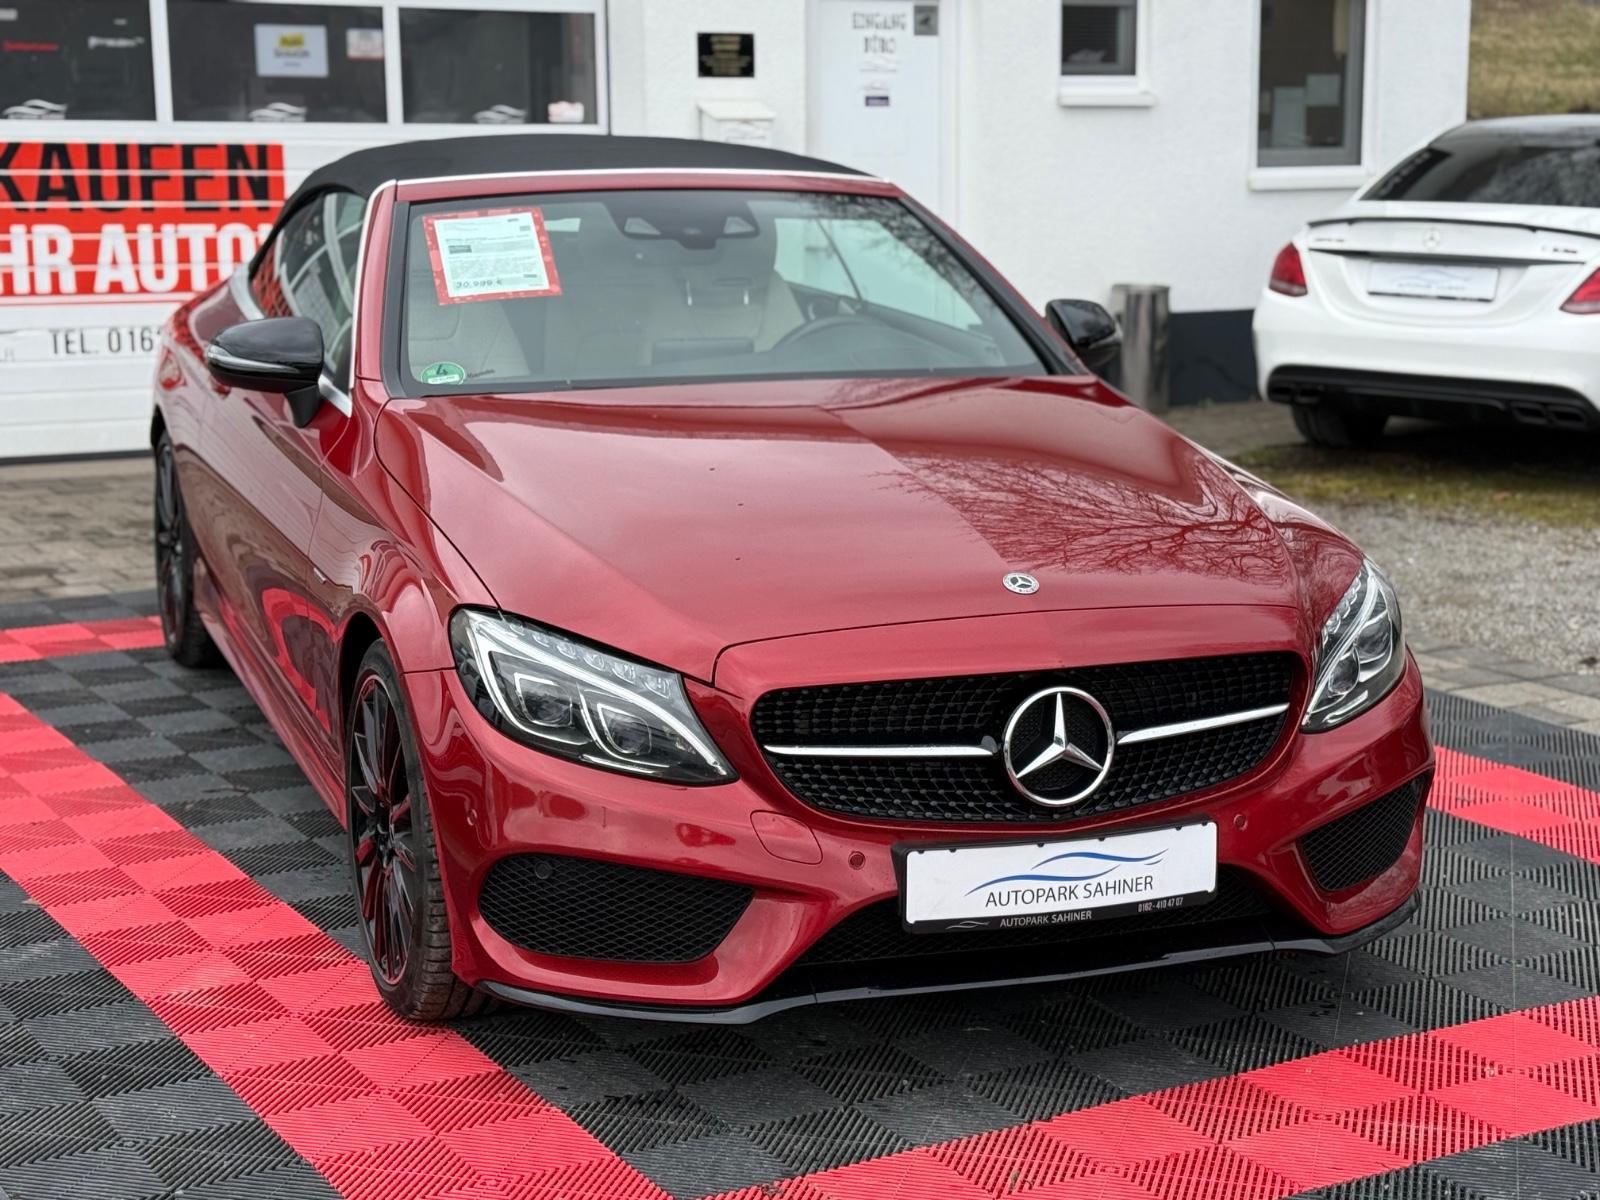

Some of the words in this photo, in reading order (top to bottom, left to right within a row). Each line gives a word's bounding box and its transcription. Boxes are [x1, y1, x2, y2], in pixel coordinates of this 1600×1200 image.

[0, 143, 271, 212] KAUFEN
[94, 223, 274, 293] AUTO
[49, 329, 99, 355] TEL.
[107, 327, 162, 353] 016
[436, 364, 449, 376] 4
[985, 884, 1079, 908] AUTOPARK
[1083, 875, 1154, 899] SAHINER
[1000, 915, 1049, 928] AUTOPARK
[1051, 910, 1092, 924] SAHINER
